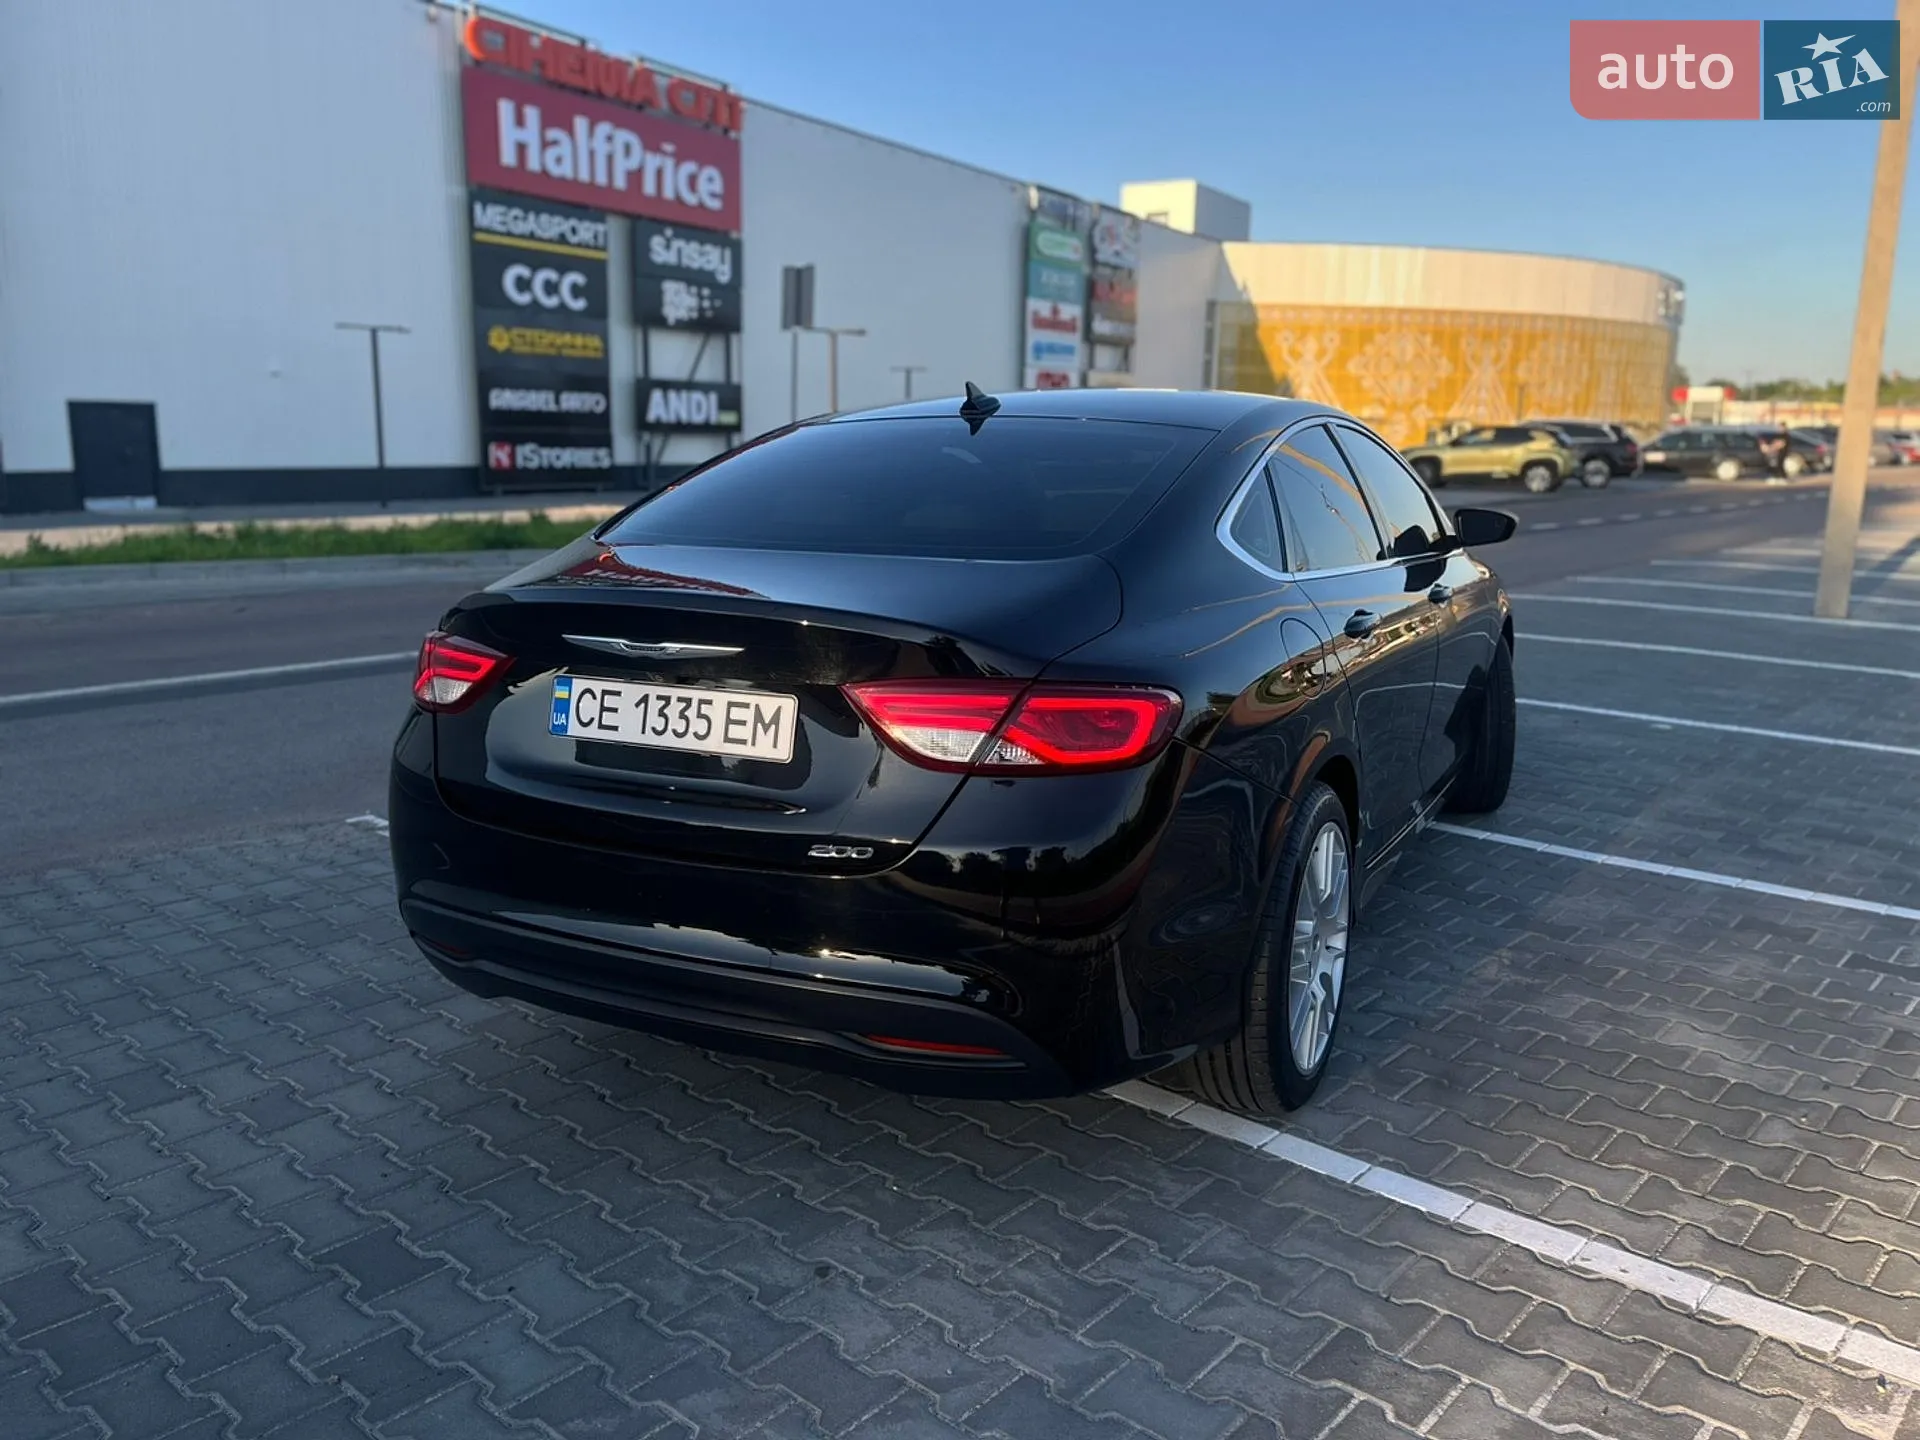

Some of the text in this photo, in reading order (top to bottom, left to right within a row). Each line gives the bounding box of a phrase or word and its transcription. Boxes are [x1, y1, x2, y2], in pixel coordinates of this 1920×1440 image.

[497, 98, 724, 210] HalfPrice
[474, 202, 607, 247] MEGASPORT
[649, 227, 732, 284] sinsay
[502, 264, 588, 311] CCC
[645, 388, 719, 425] ANDI
[553, 687, 782, 749] UA CE 1335 EM
[807, 844, 875, 858] 200
